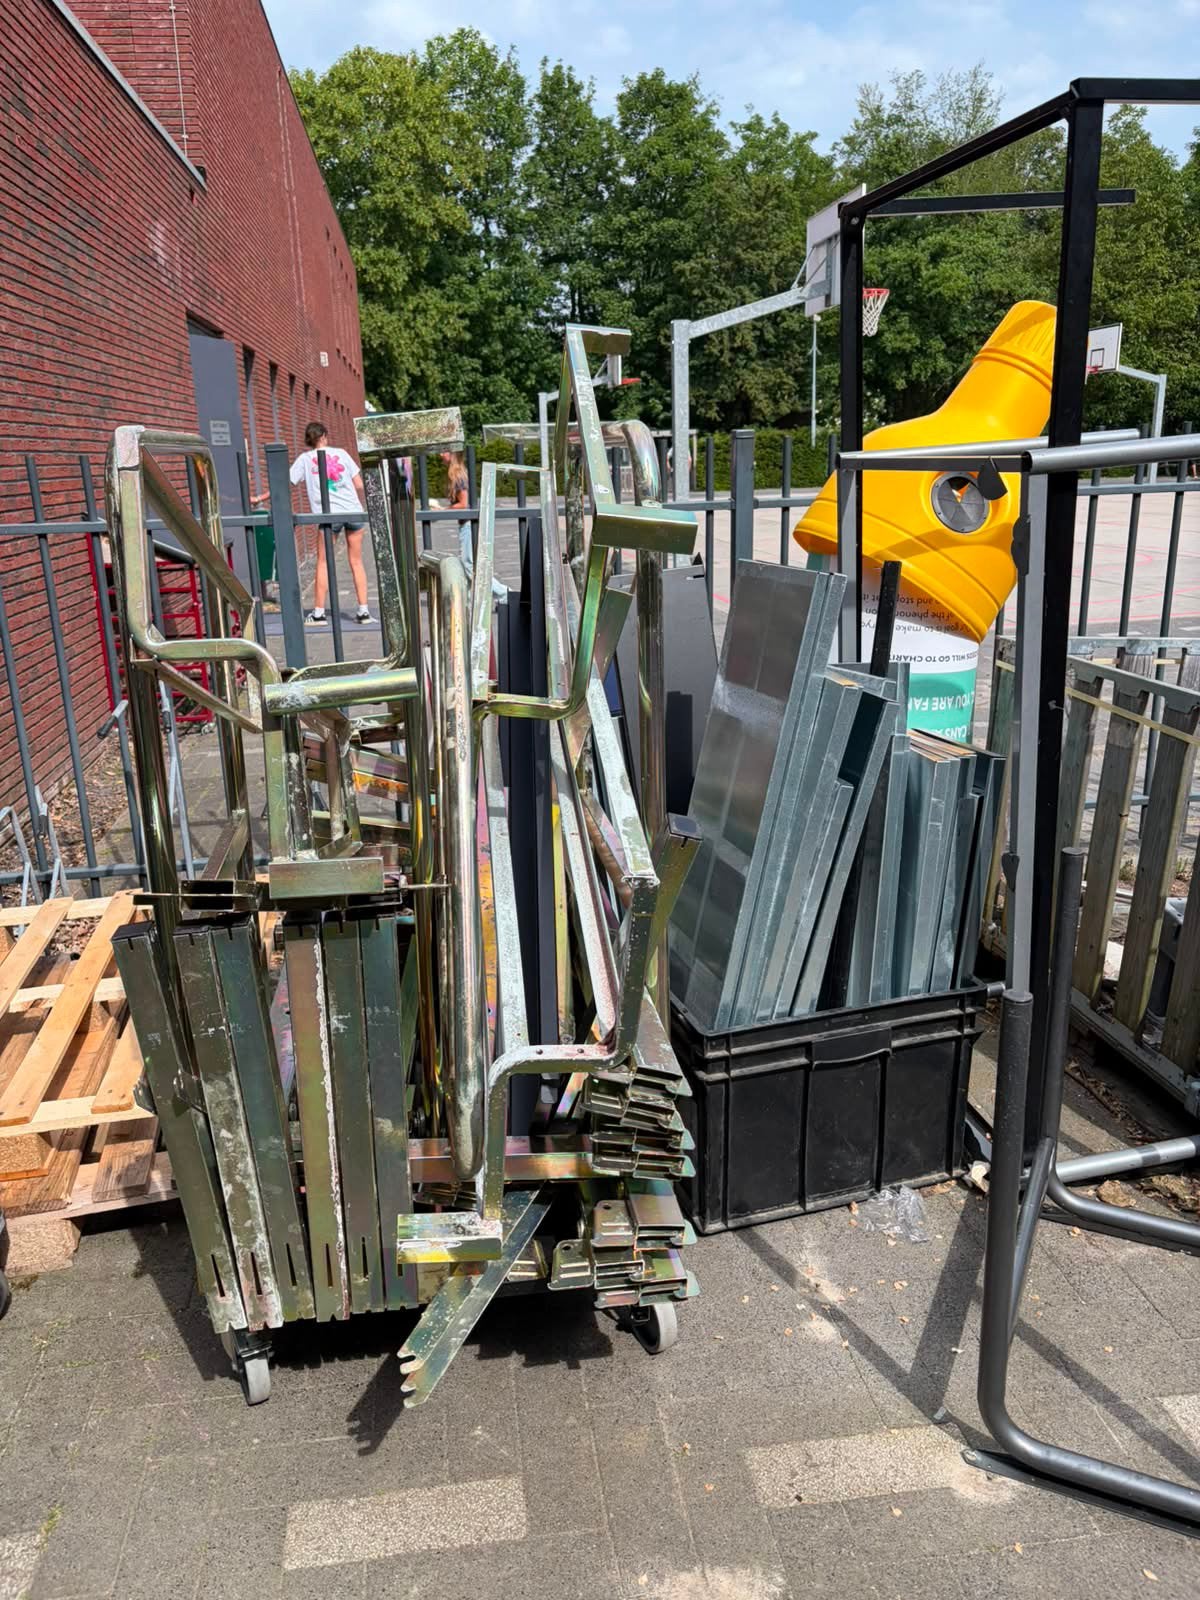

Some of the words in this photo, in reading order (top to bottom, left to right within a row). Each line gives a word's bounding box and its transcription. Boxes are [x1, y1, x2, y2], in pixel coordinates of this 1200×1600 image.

[917, 597, 933, 607] and
[930, 611, 944, 621] the
[896, 625, 921, 634] make
[925, 625, 933, 633] to
[925, 655, 936, 663] TO
[938, 654, 951, 663] GO
[951, 653, 965, 662] WILL
[931, 695, 954, 711] ARE
[955, 692, 970, 709] YOU
